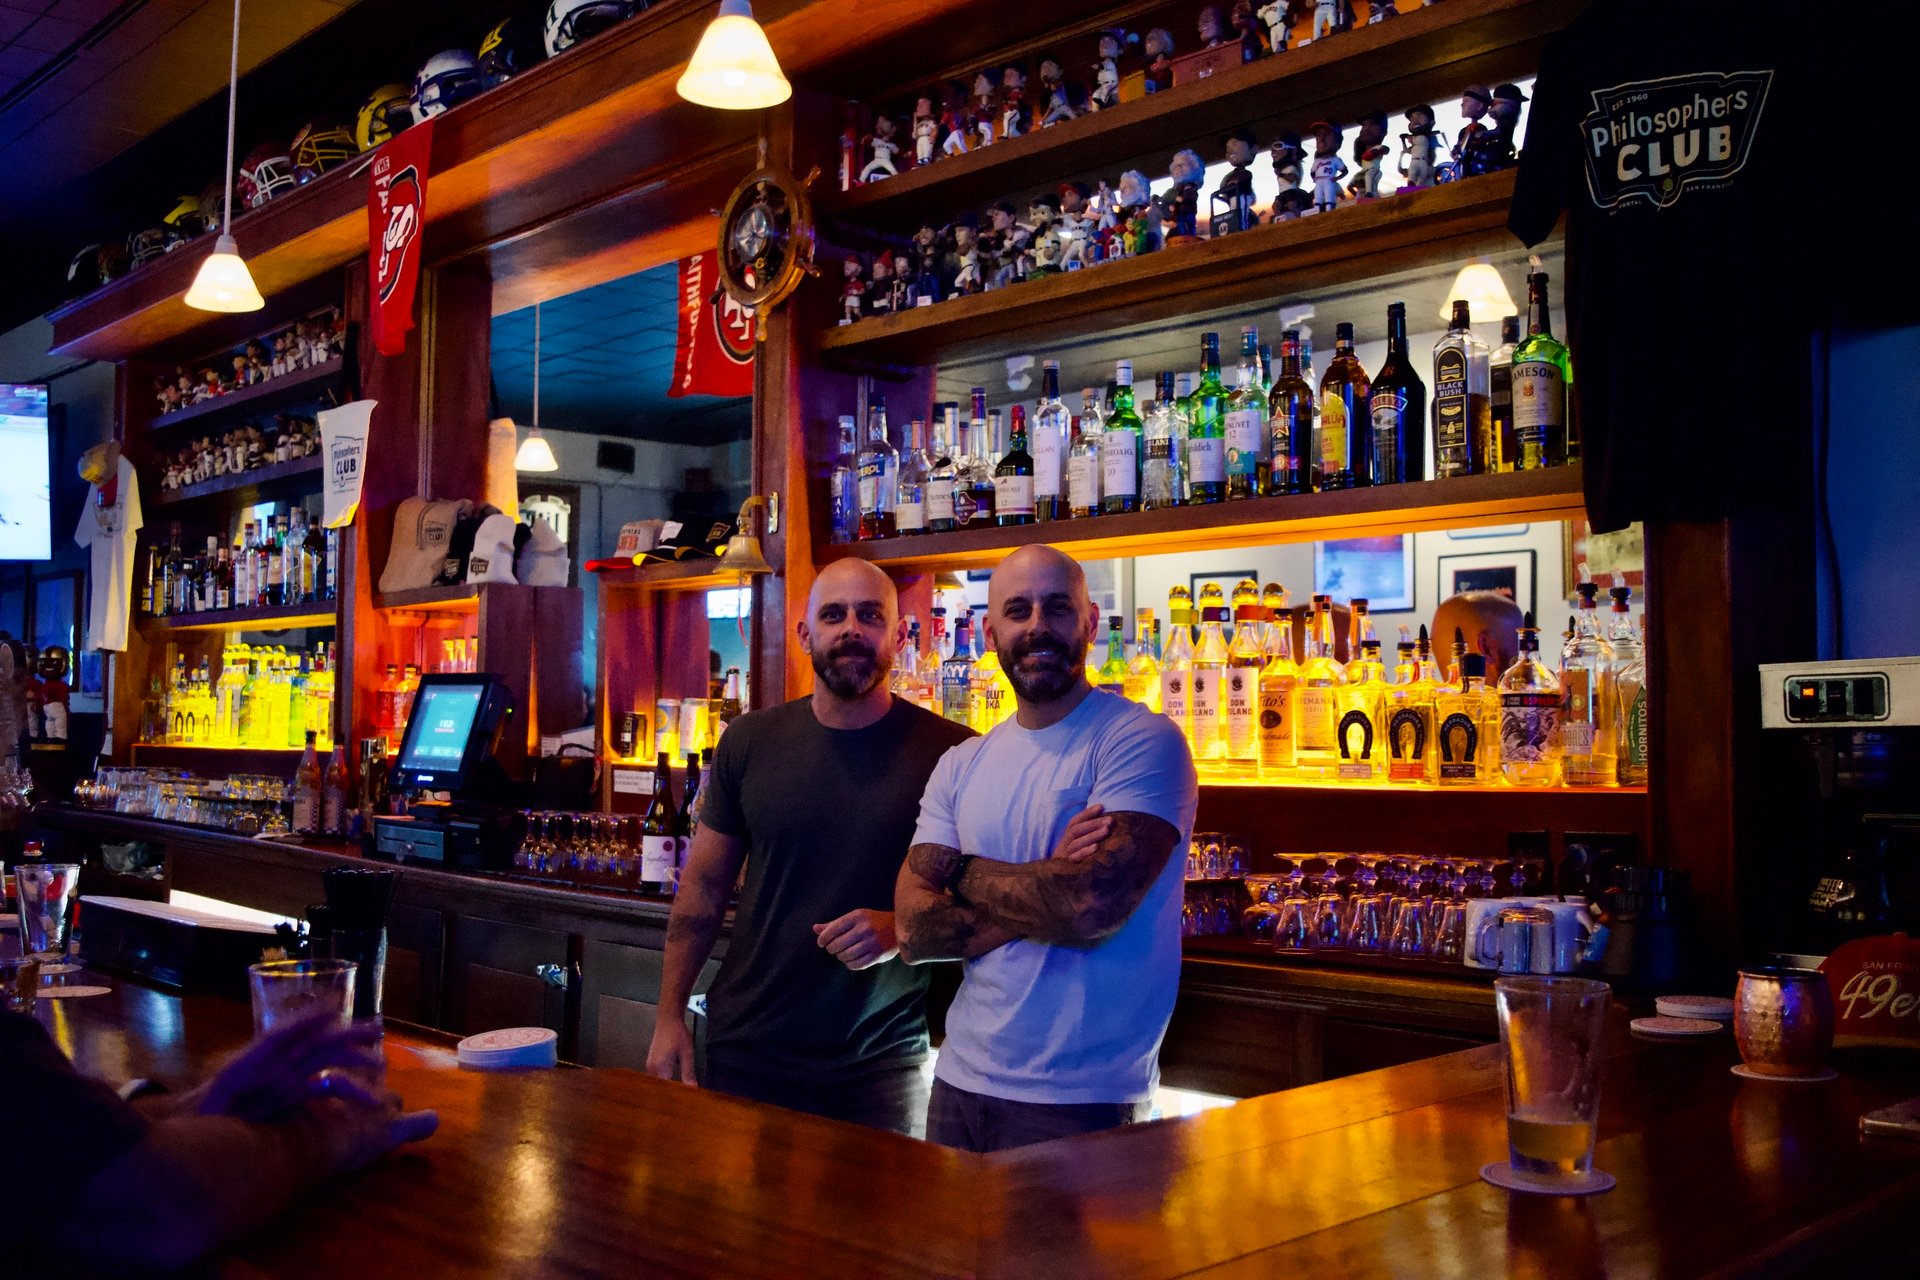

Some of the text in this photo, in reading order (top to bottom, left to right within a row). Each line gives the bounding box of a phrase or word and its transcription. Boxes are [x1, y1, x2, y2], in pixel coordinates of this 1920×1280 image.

[1627, 93, 1648, 104] 1960
[1591, 90, 1749, 157] Philosophers
[1617, 125, 1732, 182] CLUB
[1437, 381, 1464, 391] BLACK
[1439, 388, 1463, 397] BUSH
[336, 459, 357, 475] CLUB
[1168, 700, 1184, 708] DON
[1230, 699, 1245, 707] DON
[1638, 700, 1648, 763] HORNITOS
[1862, 961, 1885, 970] SAN
